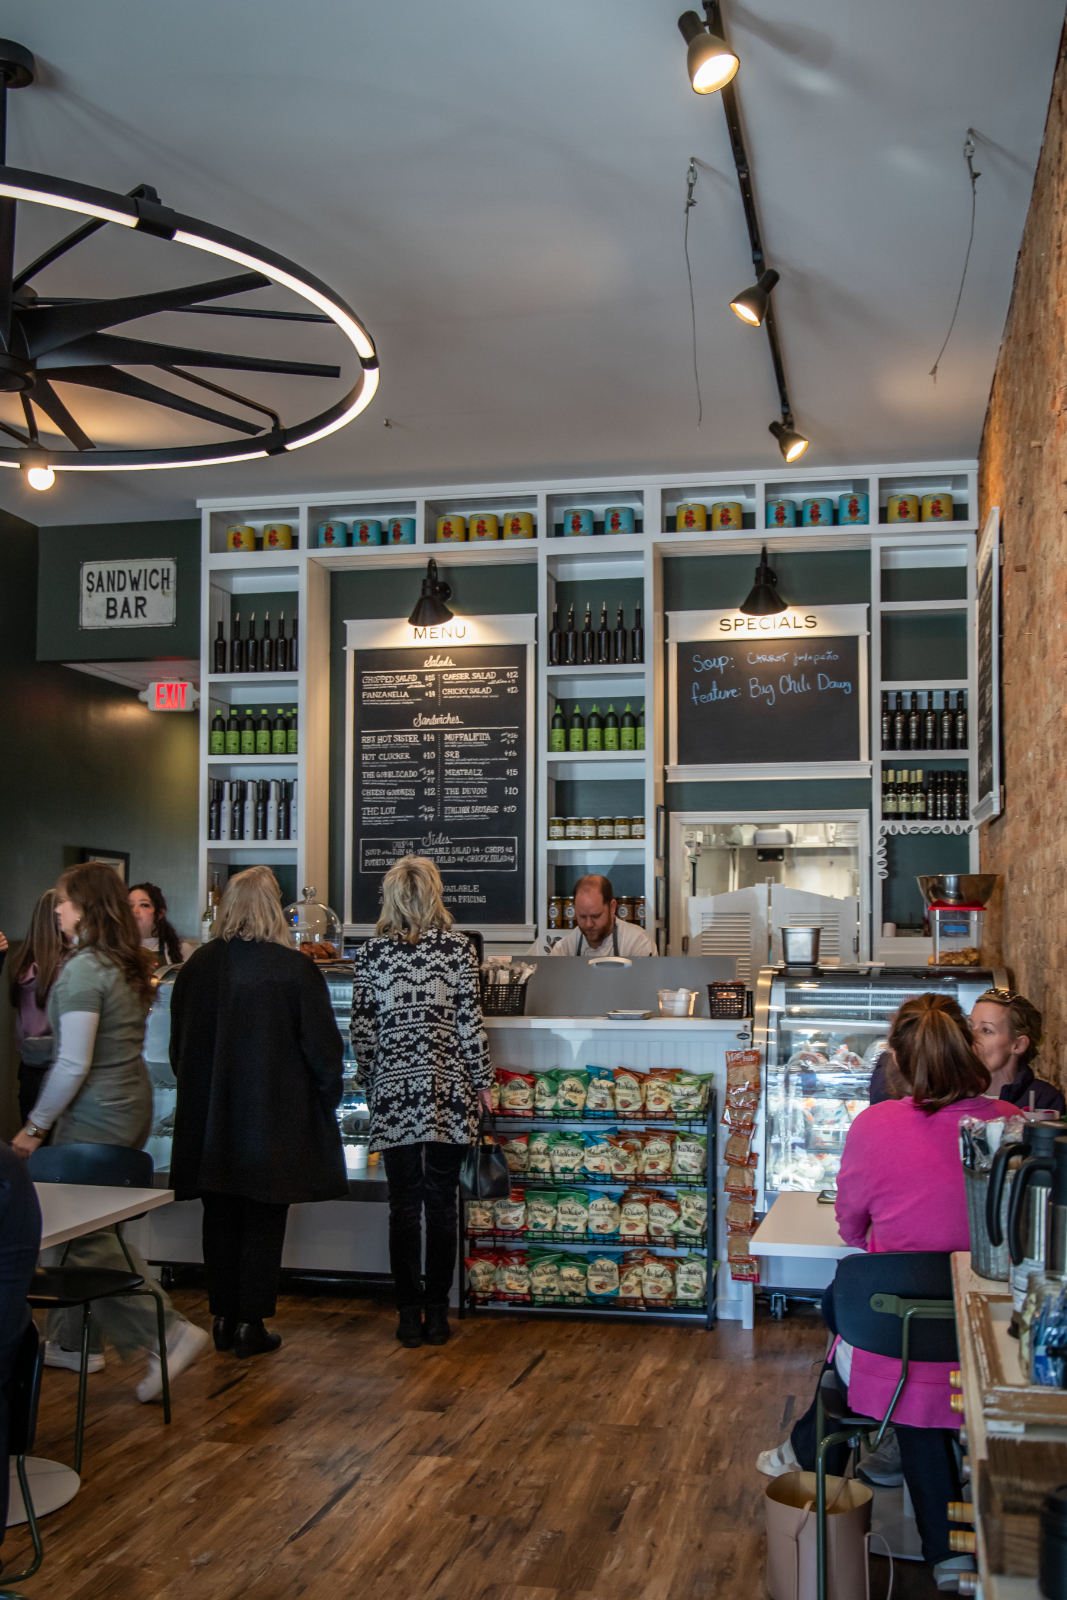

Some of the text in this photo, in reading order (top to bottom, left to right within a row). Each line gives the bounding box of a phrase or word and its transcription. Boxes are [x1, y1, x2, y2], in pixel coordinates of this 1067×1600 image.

[86, 567, 170, 593] SANDWICH
[106, 596, 147, 620] BAR
[719, 615, 817, 632] SPECIALS
[414, 626, 466, 639] MENU
[424, 655, 456, 667] Salads
[693, 654, 734, 674] Soup:
[362, 675, 394, 684] CHOPPED
[395, 674, 417, 683] SALAD
[472, 671, 496, 680] SALAD
[506, 671, 518, 679] $12
[750, 677, 775, 706] Big
[780, 674, 810, 694] Chili
[818, 673, 851, 695] Dawg
[155, 683, 188, 710] EXIT
[362, 691, 409, 699] PANZANELLA
[414, 713, 463, 727] Sandwiches
[377, 735, 392, 743] HOT
[393, 734, 419, 743] SISTER
[423, 734, 435, 742] $14
[362, 752, 435, 761] HOT CLUCKER $10
[362, 771, 374, 779] THE
[362, 788, 435, 797] CHEESY GOODNESS $12
[462, 787, 487, 795] DEVON
[505, 787, 518, 795] $10
[362, 807, 379, 815] THE
[380, 807, 396, 815] LOU
[444, 806, 470, 814] ITALIAN
[422, 831, 452, 847] Sides
[365, 849, 381, 857] SOUP
[452, 847, 471, 855] SALAD
[458, 896, 486, 904] PRICING
